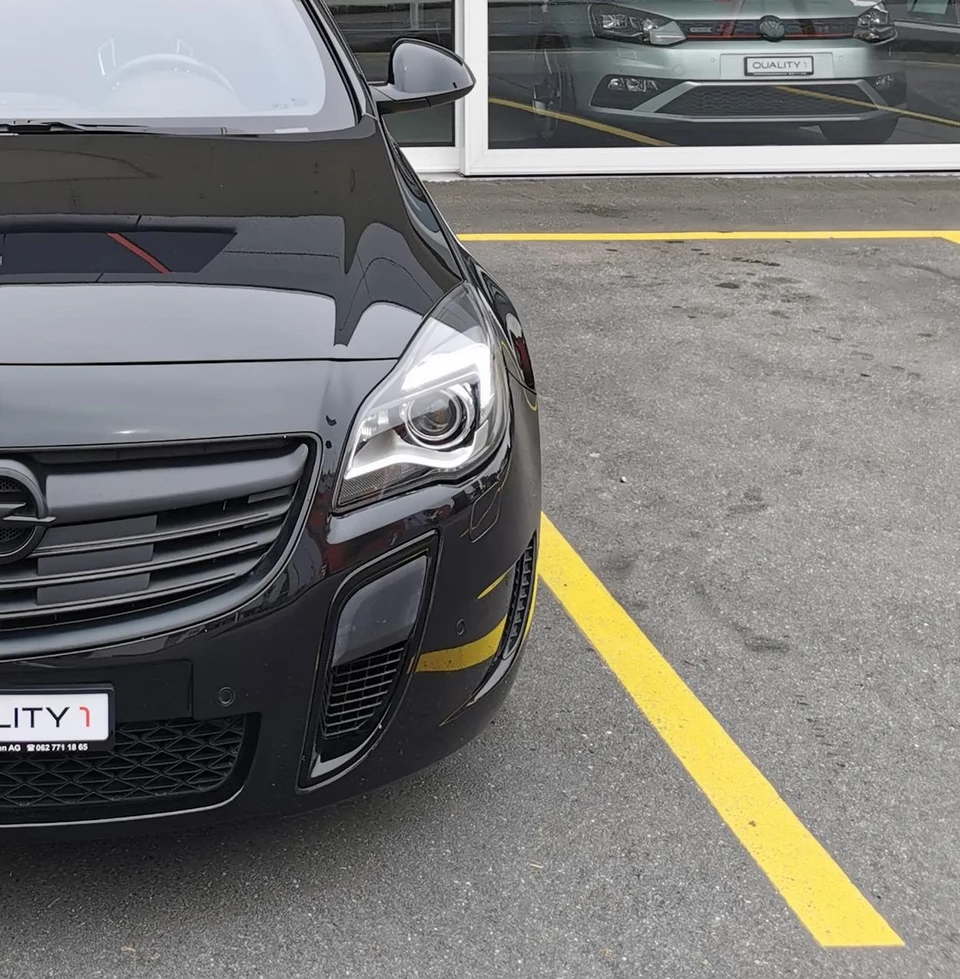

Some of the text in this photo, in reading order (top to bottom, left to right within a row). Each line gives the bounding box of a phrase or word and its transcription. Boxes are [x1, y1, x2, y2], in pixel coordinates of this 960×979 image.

[752, 61, 801, 69] QUALITY
[79, 706, 91, 727] 1
[8, 744, 21, 752] AG
[35, 744, 50, 752] 062
[67, 743, 77, 751] 18
[78, 742, 88, 751] 65
